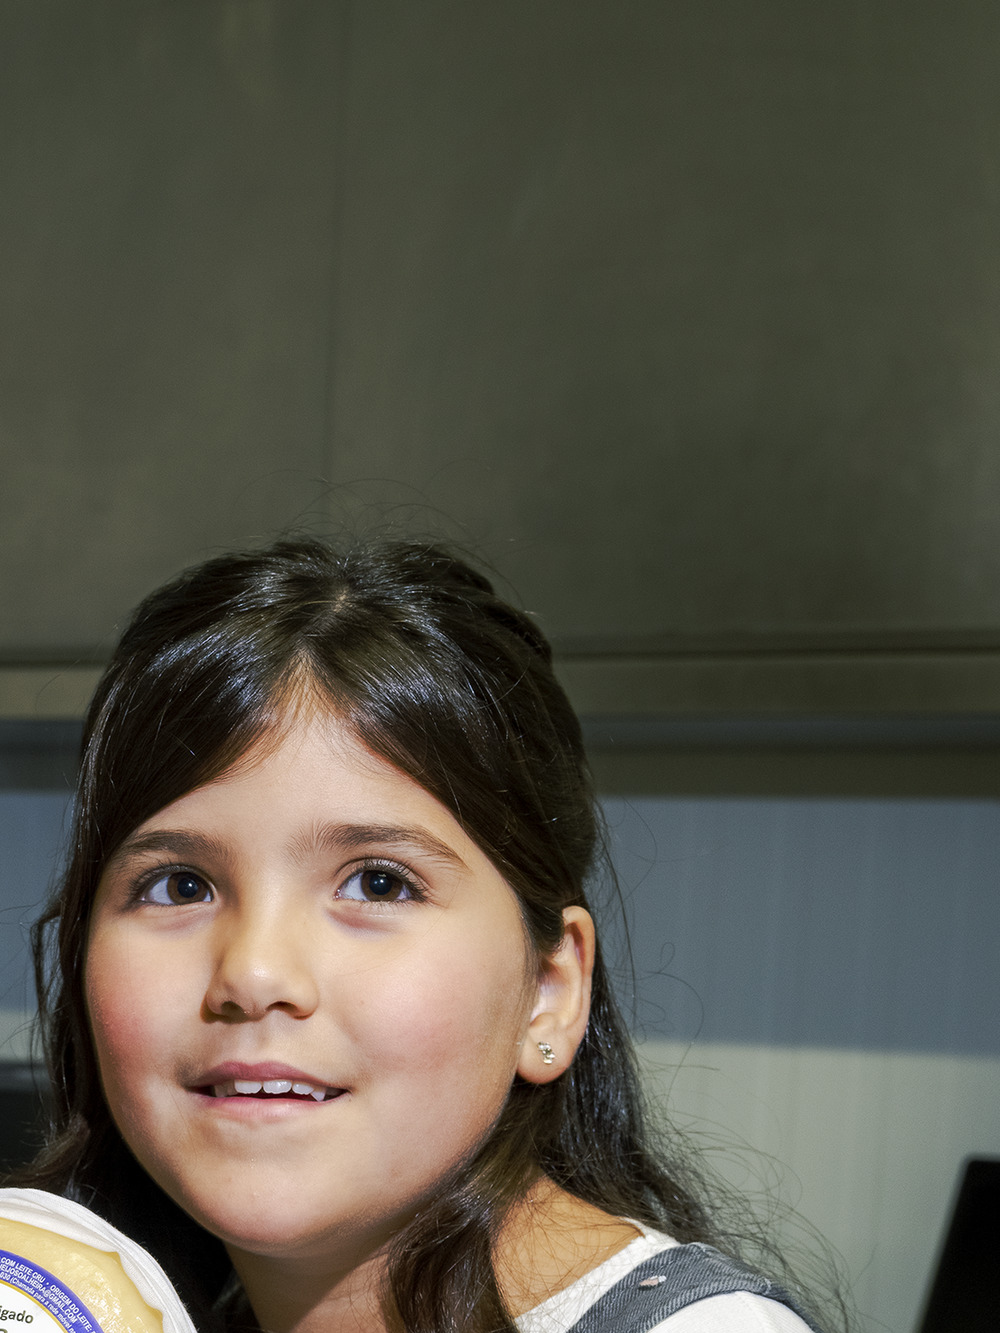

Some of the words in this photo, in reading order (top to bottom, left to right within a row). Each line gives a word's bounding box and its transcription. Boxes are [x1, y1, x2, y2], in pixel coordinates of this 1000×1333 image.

[0, 1257, 16, 1267] COM
[15, 1262, 34, 1276] LEITE
[32, 1271, 46, 1283] CRU
[50, 1284, 73, 1305] ORIGEM
[69, 1302, 80, 1314] DO
[76, 1312, 93, 1332] LEITE:
